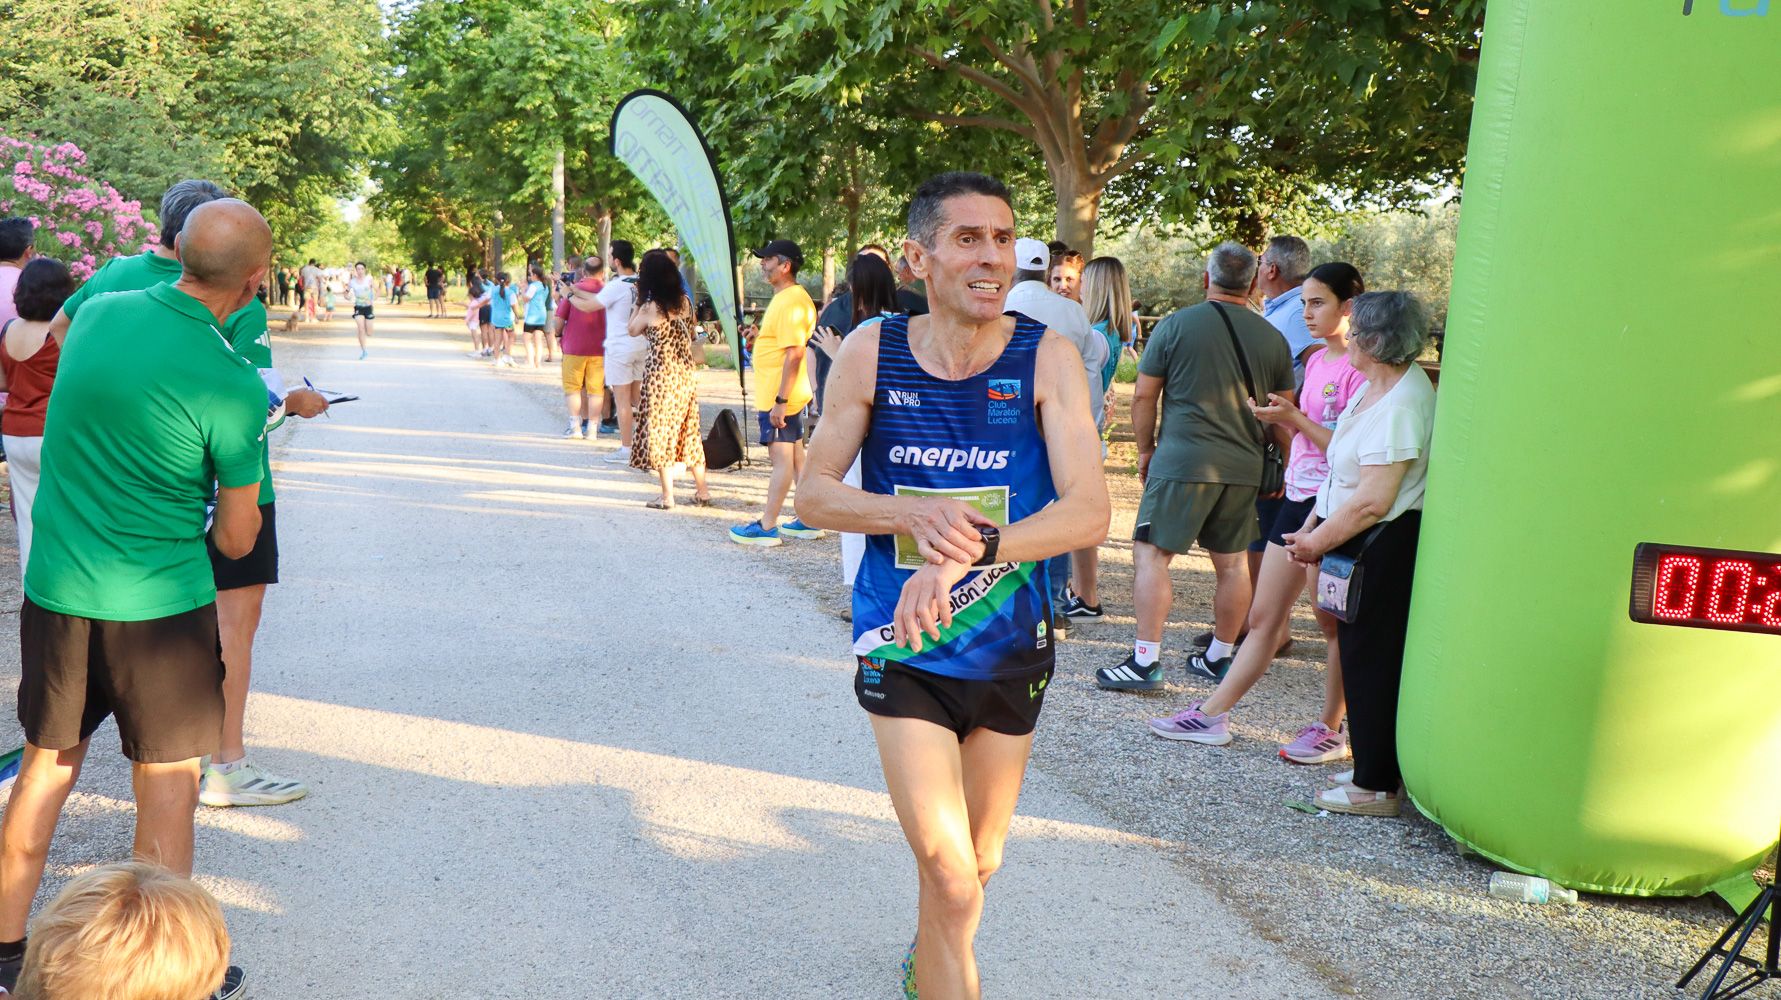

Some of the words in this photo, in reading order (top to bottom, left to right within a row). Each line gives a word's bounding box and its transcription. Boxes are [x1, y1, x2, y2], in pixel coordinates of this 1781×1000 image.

[901, 391, 919, 399] RUN
[903, 398, 921, 407] PRO
[987, 400, 1007, 409] Club
[987, 408, 1020, 416] Maratón
[987, 416, 1017, 425] Lucena
